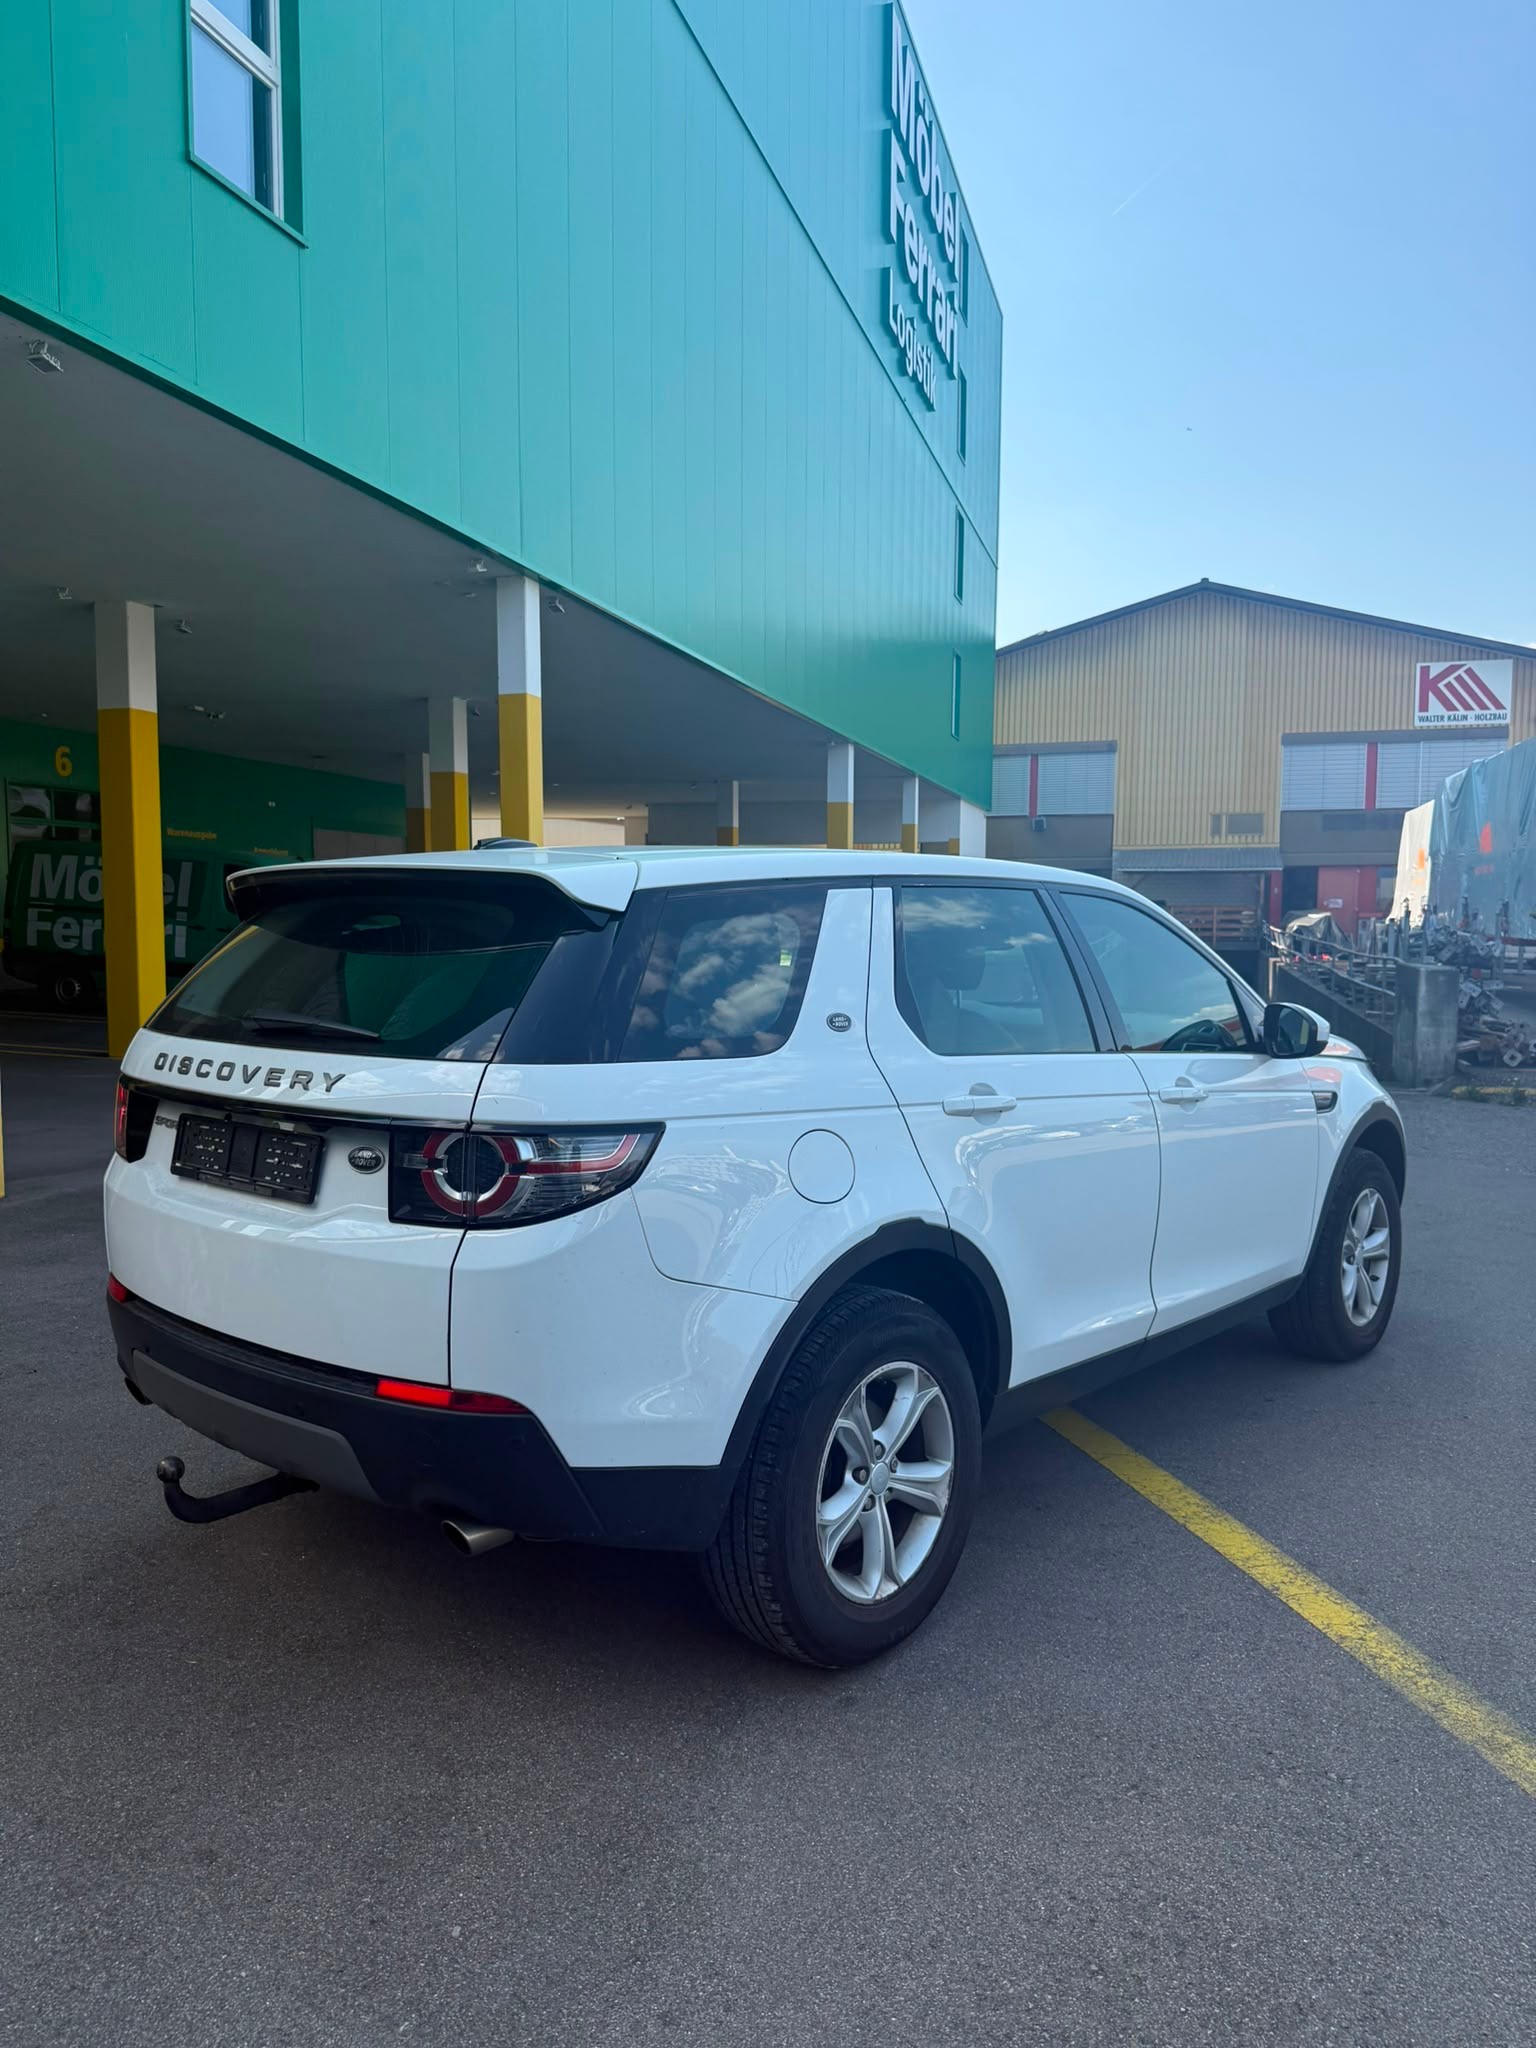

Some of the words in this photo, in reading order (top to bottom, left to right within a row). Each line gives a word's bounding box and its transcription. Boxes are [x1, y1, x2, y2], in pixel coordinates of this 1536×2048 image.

[892, 3, 959, 282] Möbel
[889, 129, 959, 380] Ferrari
[889, 267, 937, 411] Logistik
[1418, 714, 1445, 723] WALTER
[1447, 713, 1468, 723] KÄLIN
[1474, 712, 1508, 721] HOLZBAU
[55, 745, 74, 778] 6
[29, 853, 193, 908] Möl
[26, 907, 188, 958] Feri
[153, 1052, 346, 1093] DISCOVERY
